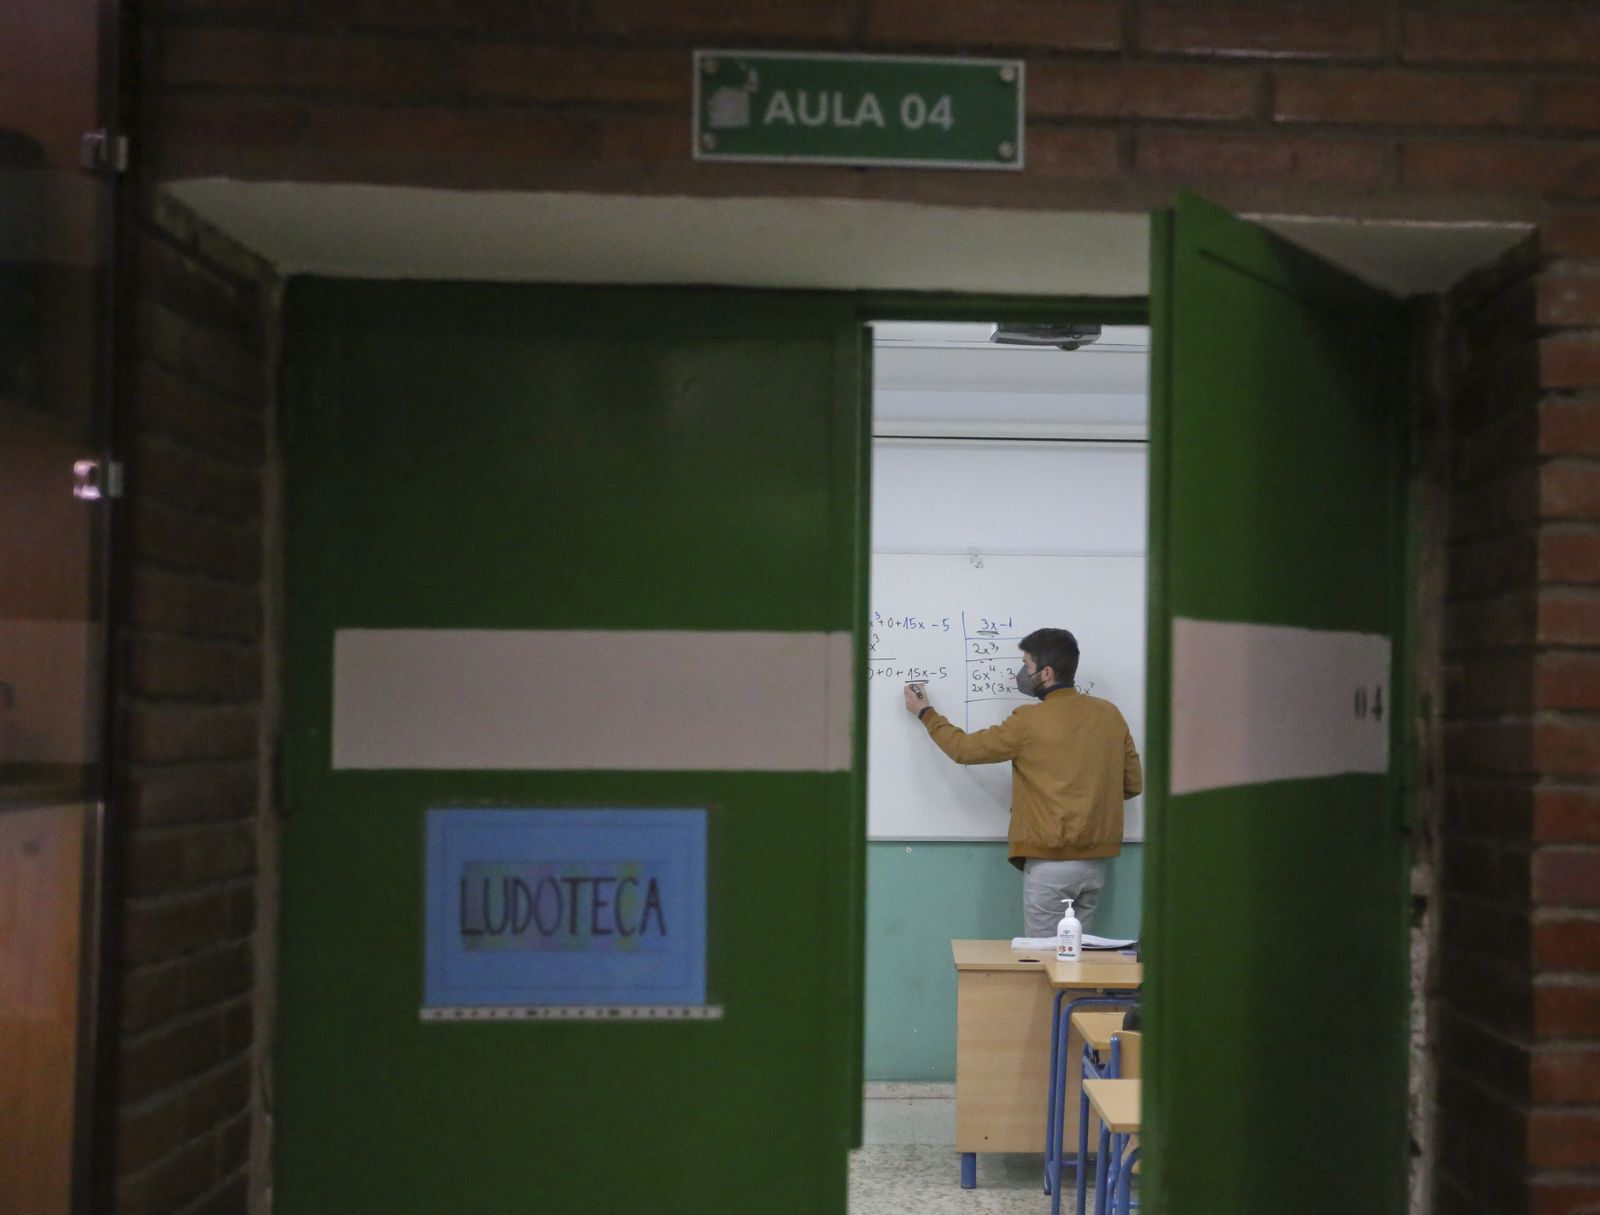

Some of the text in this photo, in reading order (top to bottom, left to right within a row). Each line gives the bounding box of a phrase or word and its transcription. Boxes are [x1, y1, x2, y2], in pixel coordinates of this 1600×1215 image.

[763, 89, 955, 130] AULA 04
[458, 876, 668, 938] LUDOTECA
